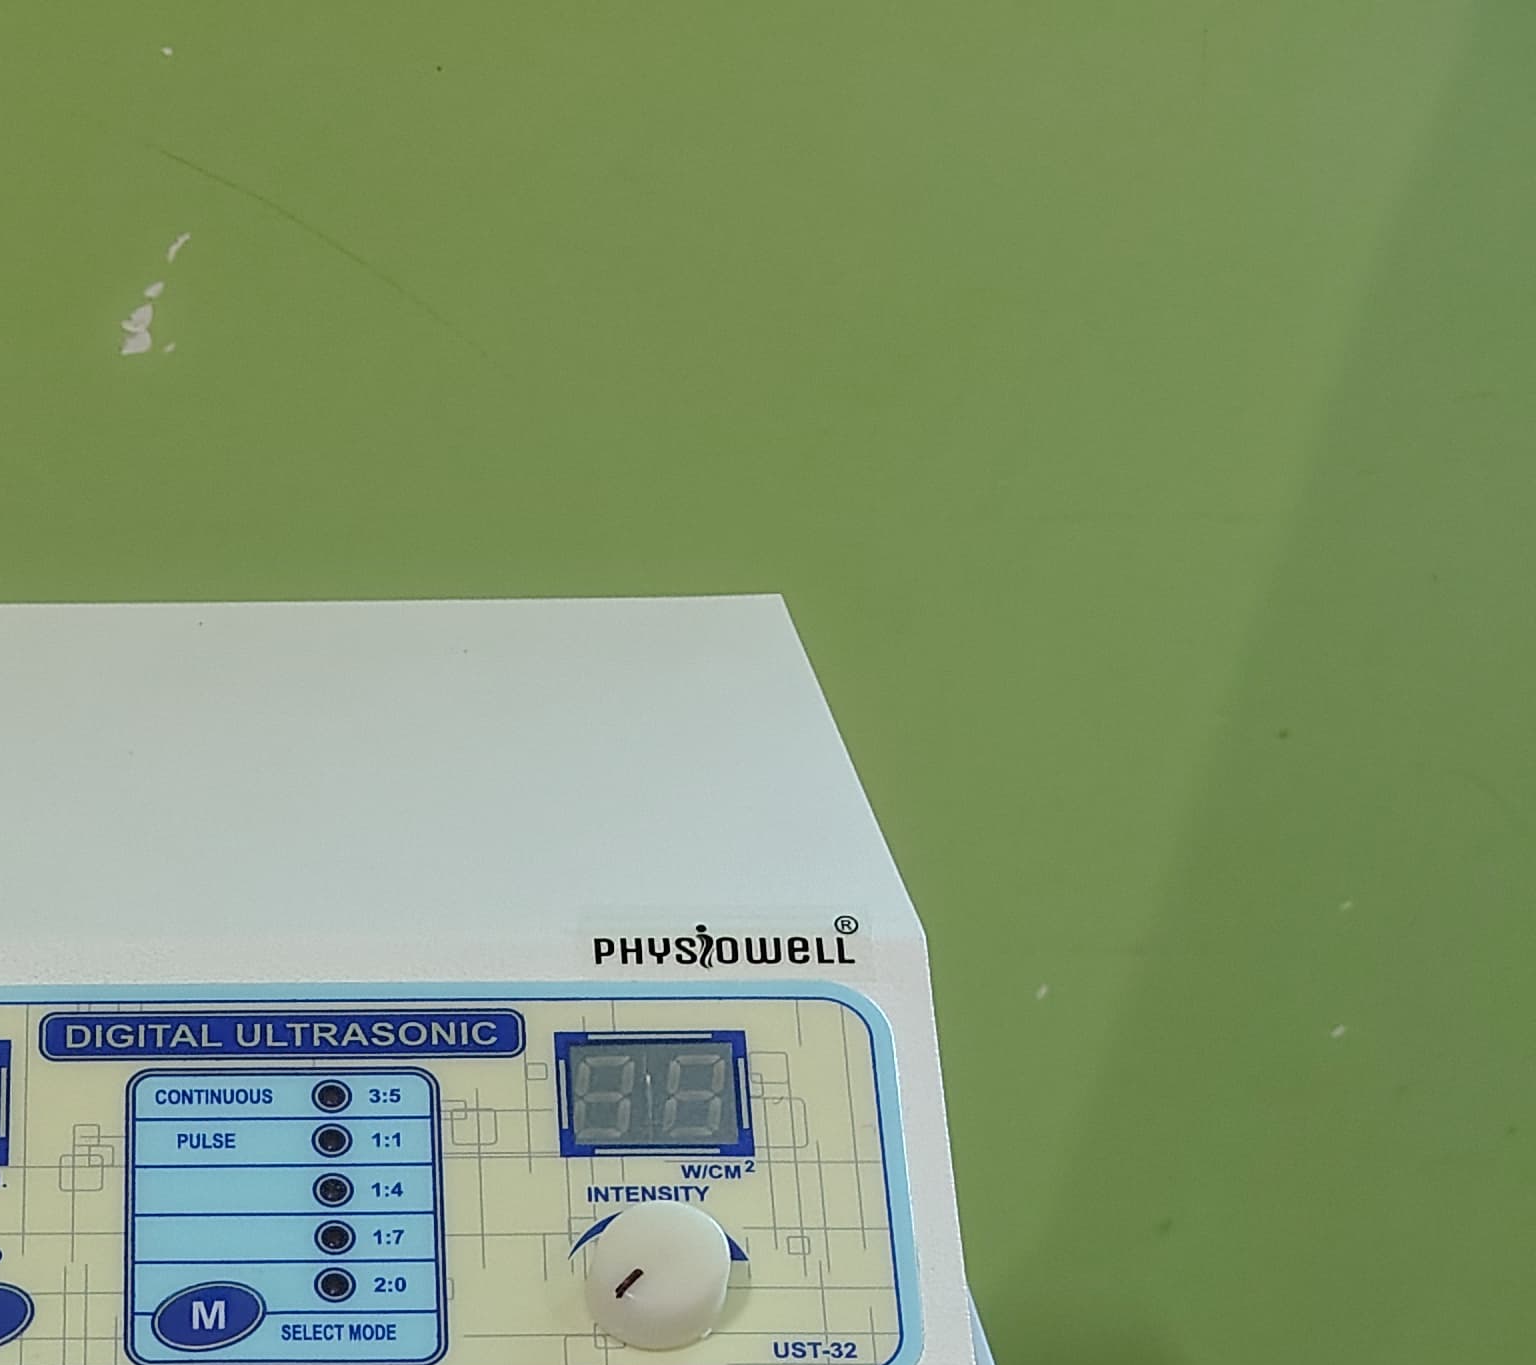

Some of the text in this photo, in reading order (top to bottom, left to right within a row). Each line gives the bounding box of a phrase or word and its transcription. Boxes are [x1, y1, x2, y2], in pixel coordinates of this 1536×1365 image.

[65, 1020, 499, 1048] DIGITAL ULTRASONIC
[154, 1088, 402, 1106] CONTINUOUS 3:5
[176, 1133, 402, 1150] PULSE 1:1
[371, 1182, 404, 1198] 1:4
[587, 1185, 709, 1202] INTENSITY
[373, 1229, 405, 1245] 1:7
[373, 1277, 407, 1293] 2:0
[191, 1300, 226, 1330] M
[280, 1324, 397, 1341] SELECT MODE
[772, 1341, 858, 1359] UST-32
